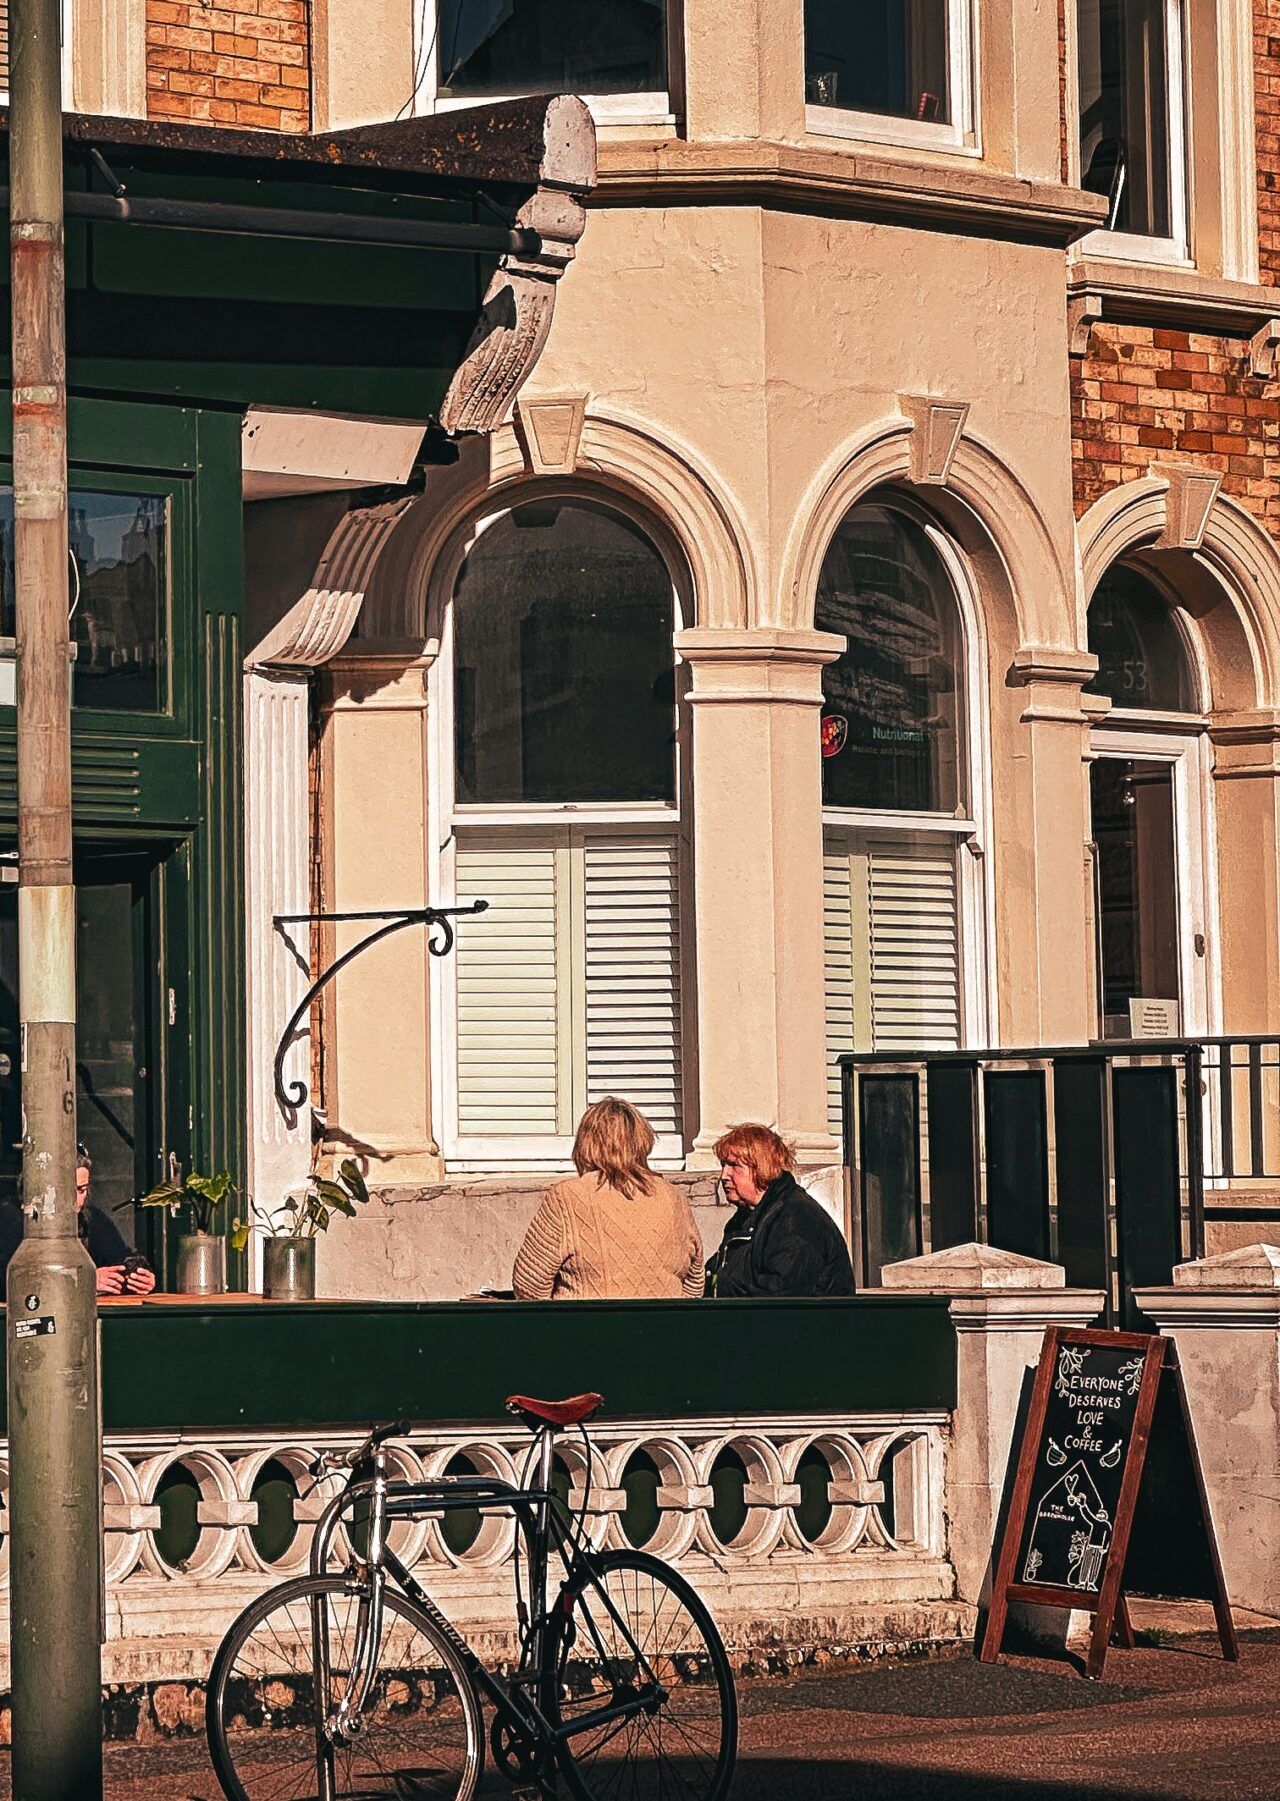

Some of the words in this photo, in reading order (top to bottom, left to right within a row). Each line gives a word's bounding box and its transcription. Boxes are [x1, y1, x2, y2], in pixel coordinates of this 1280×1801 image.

[1122, 660, 1147, 691] 53
[872, 726, 925, 743] Nutritional
[1070, 1375, 1126, 1392] EVERYONE
[1068, 1393, 1122, 1409] DESERVES
[1076, 1410, 1105, 1426] LOVE
[1082, 1425, 1093, 1439] &
[1064, 1434, 1104, 1452] COFFEE
[1050, 1504, 1065, 1513] THE
